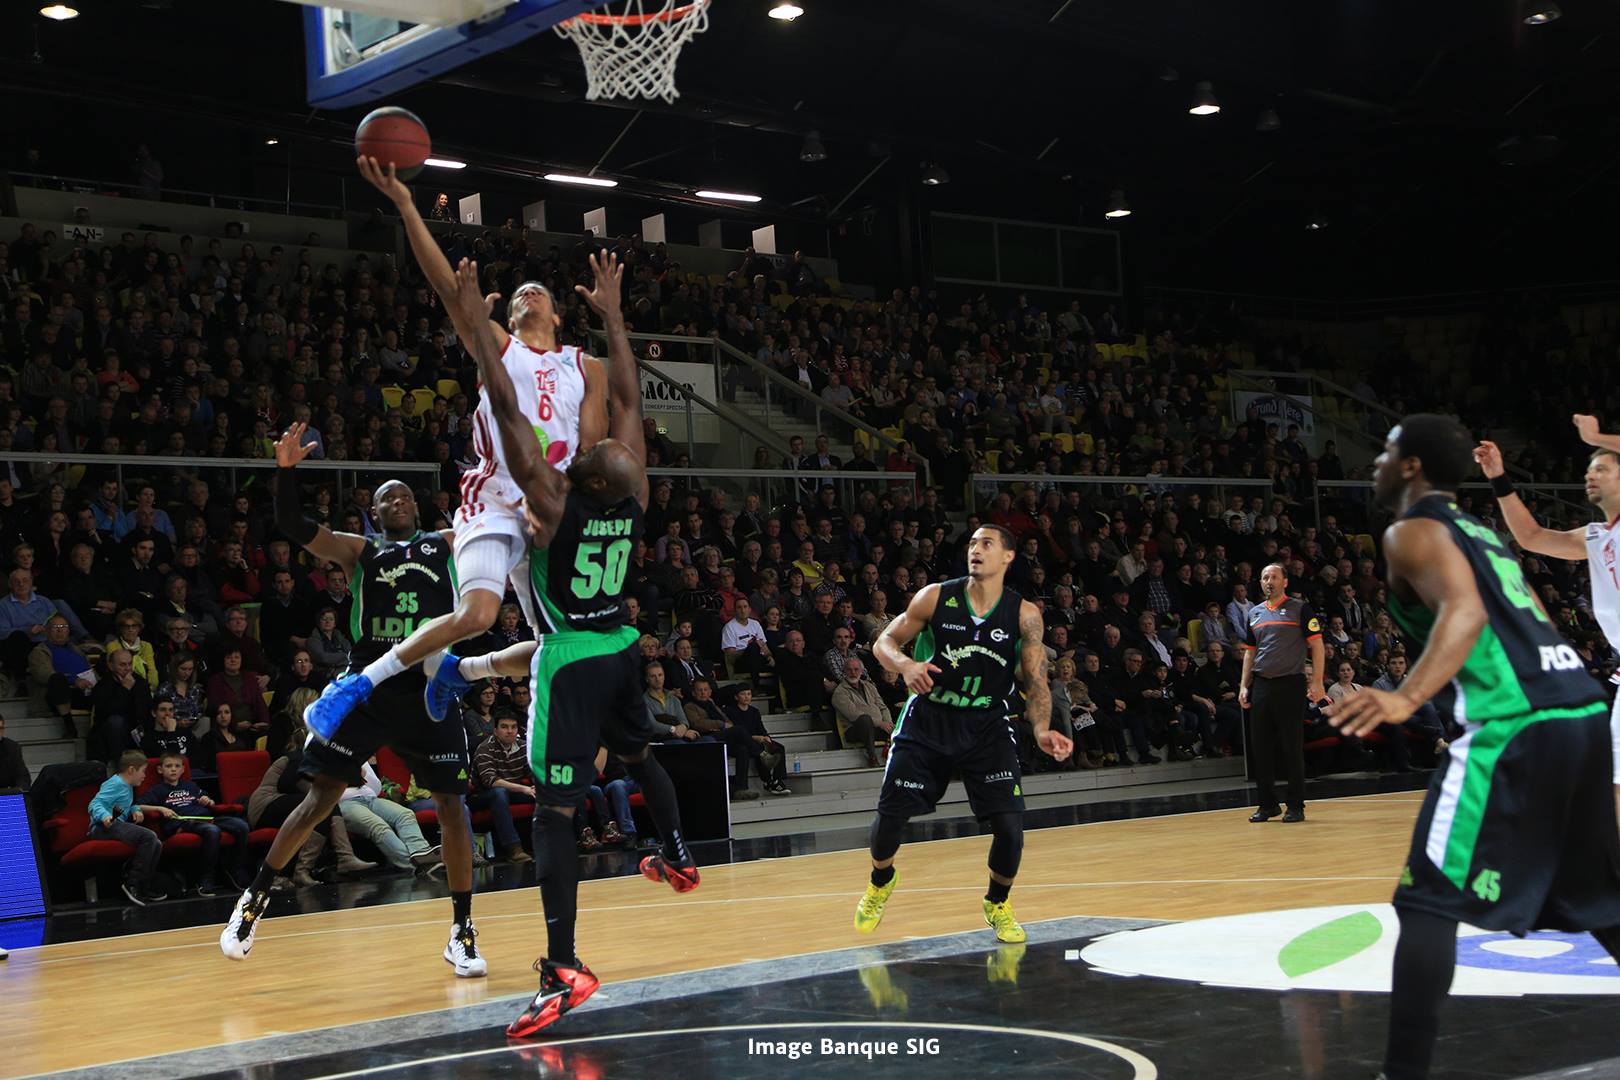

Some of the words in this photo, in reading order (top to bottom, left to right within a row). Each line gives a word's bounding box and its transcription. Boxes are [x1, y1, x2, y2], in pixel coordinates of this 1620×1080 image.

[651, 345, 659, 355] N
[641, 381, 694, 400] ACCO
[538, 394, 552, 421] 6
[583, 518, 633, 536] JOSEPH
[570, 538, 632, 599] 50
[395, 592, 419, 614] 35
[960, 676, 982, 697] 11
[550, 764, 574, 785] 50
[1472, 868, 1502, 902] 45
